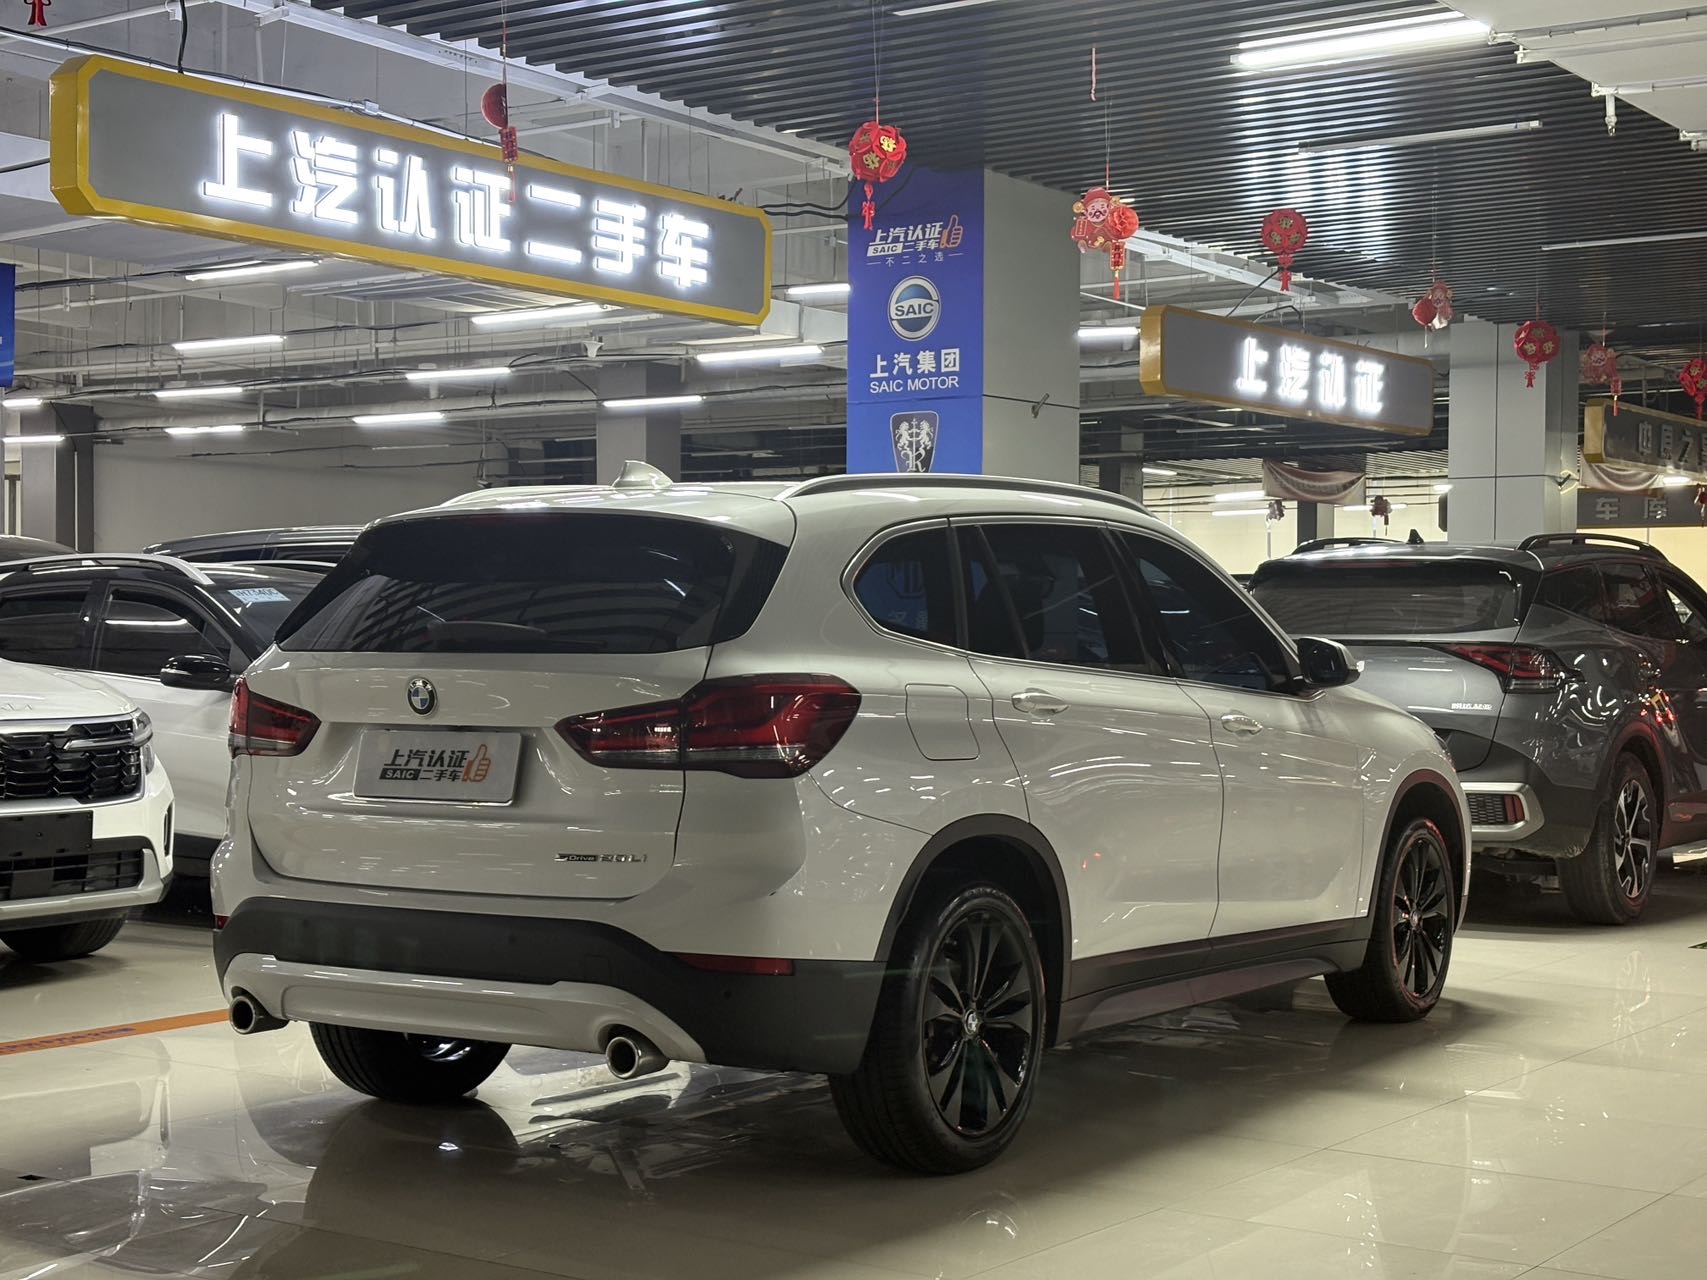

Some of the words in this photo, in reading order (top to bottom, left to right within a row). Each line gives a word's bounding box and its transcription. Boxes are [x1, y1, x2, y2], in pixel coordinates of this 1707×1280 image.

[202, 113, 710, 289] 上汽认证二手车
[869, 222, 944, 246] 上汽认证
[872, 245, 898, 254] SAIC
[902, 239, 940, 252] 二手车
[885, 251, 944, 267] 不二之选
[894, 302, 934, 317] SAIC
[869, 348, 960, 378] 上汽集团
[1234, 336, 1385, 415] 上汽认证
[869, 379, 903, 394] SAIC
[907, 375, 959, 391] MOTOR
[384, 749, 470, 768] 上汽认证
[385, 769, 416, 779] SAIC
[419, 768, 463, 781] 二手车
